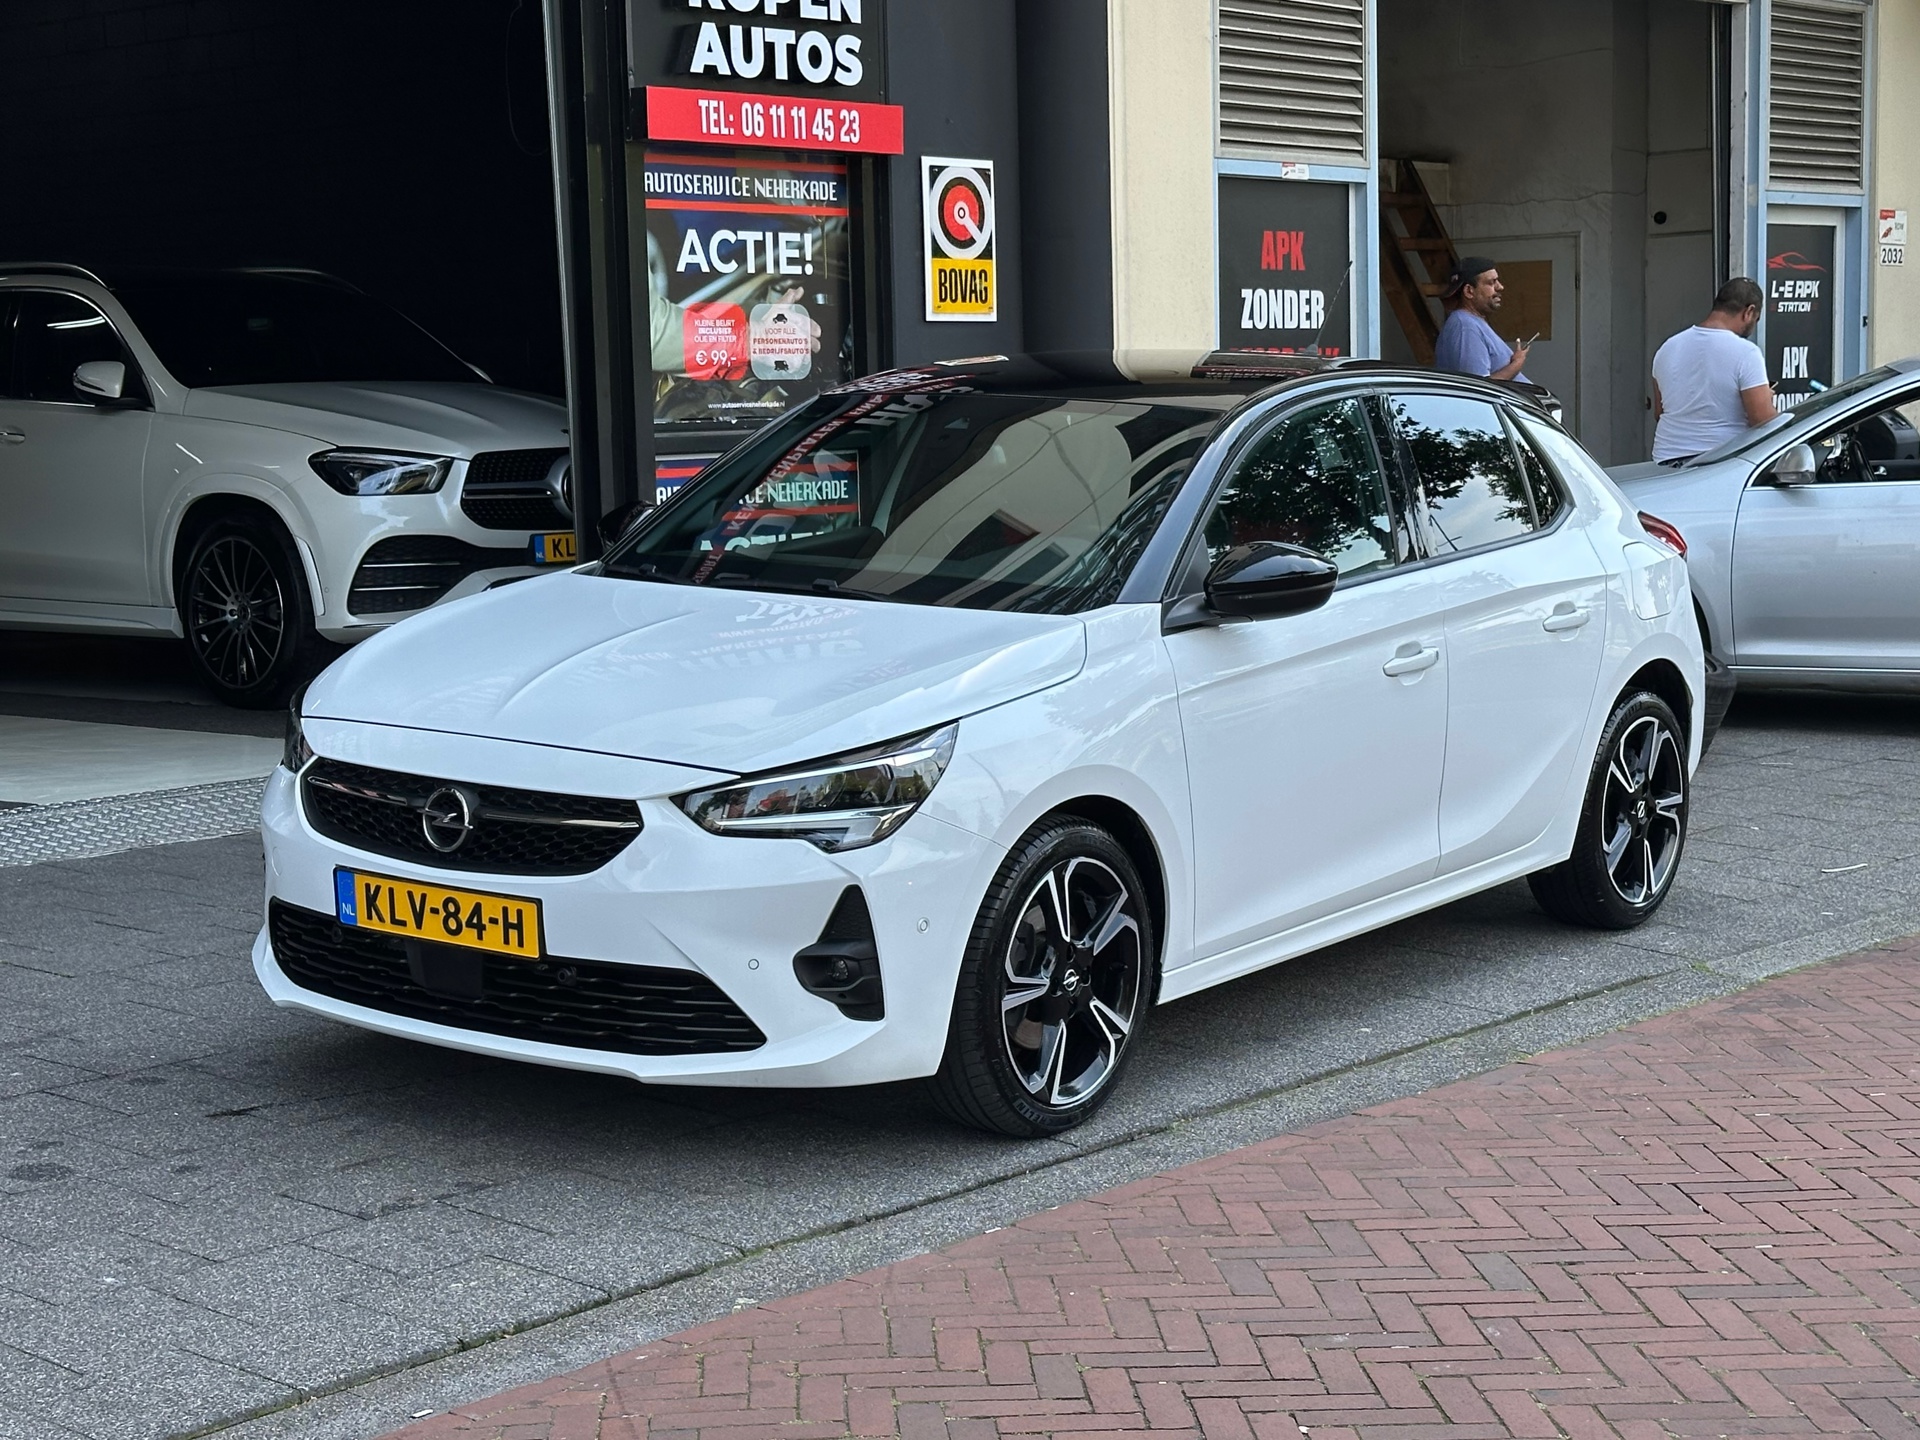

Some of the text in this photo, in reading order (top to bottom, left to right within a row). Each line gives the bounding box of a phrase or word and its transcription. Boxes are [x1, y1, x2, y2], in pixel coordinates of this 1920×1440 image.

[690, 21, 863, 86] AUTOS
[698, 99, 861, 143] TEL: 06 11 11 45 23
[644, 171, 837, 201] AUTOSERVICE NEHERKADE
[676, 228, 814, 275] ACTIE!
[1261, 230, 1306, 271] APK
[1881, 248, 1903, 264] 2032
[938, 268, 988, 304] BOVAG
[1771, 280, 1820, 298] L-E APK
[1241, 288, 1325, 330] ZONDER
[1777, 301, 1811, 312] STATION
[696, 350, 708, 365] €
[1782, 346, 1808, 379] APK
[767, 480, 849, 503] NEHERKADE
[342, 902, 355, 916] NL
[364, 882, 525, 948] KLV-84-H
